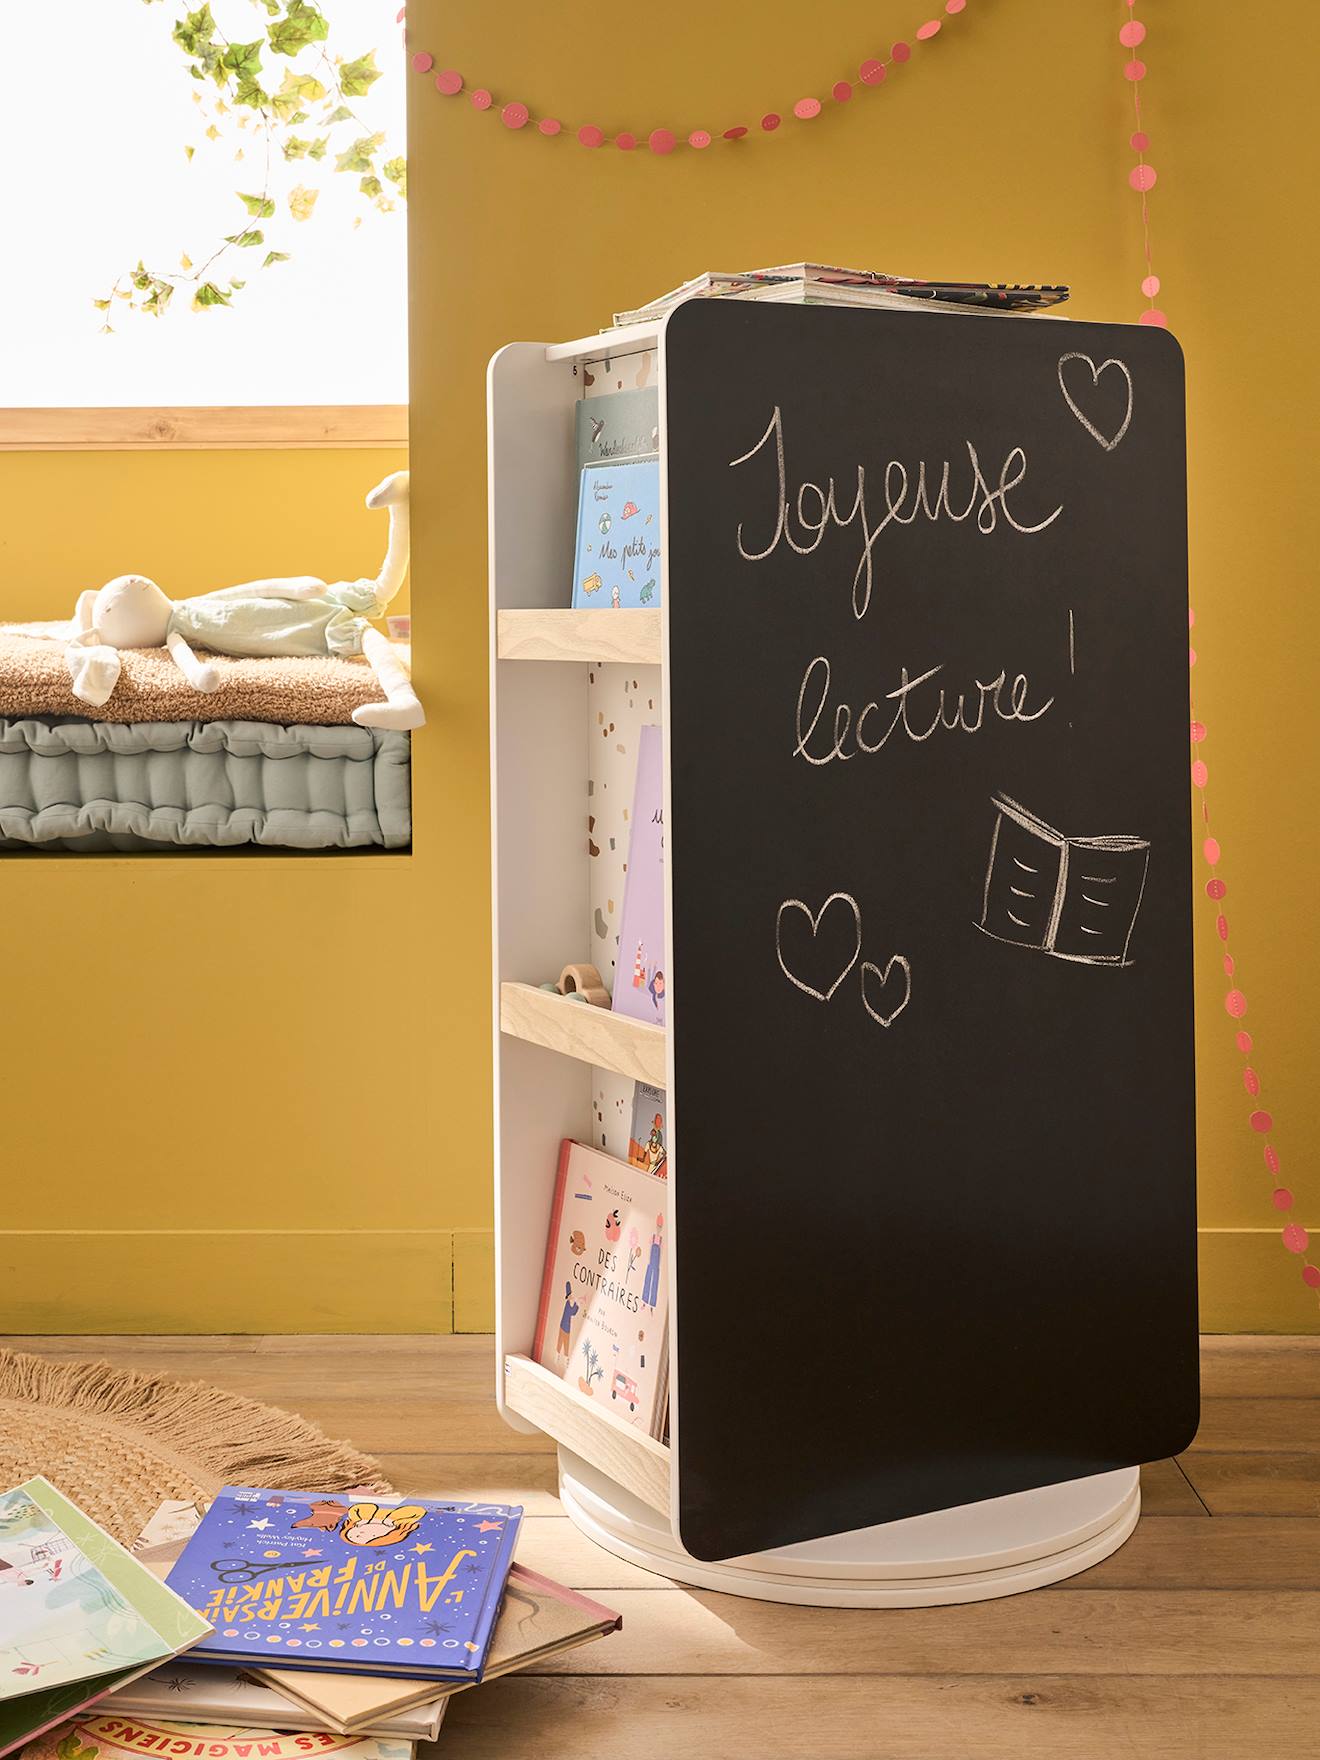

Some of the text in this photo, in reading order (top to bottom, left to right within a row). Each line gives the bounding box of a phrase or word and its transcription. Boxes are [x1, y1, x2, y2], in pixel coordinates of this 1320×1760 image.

[729, 406, 1063, 619] Joyeuse
[599, 541, 617, 559] Mes
[621, 536, 646, 570] petits
[793, 609, 1075, 765] lecture !
[598, 1248, 617, 1272] DES
[364, 1560, 387, 1575] DE
[98, 1720, 352, 1757] ES MAGICIENS
